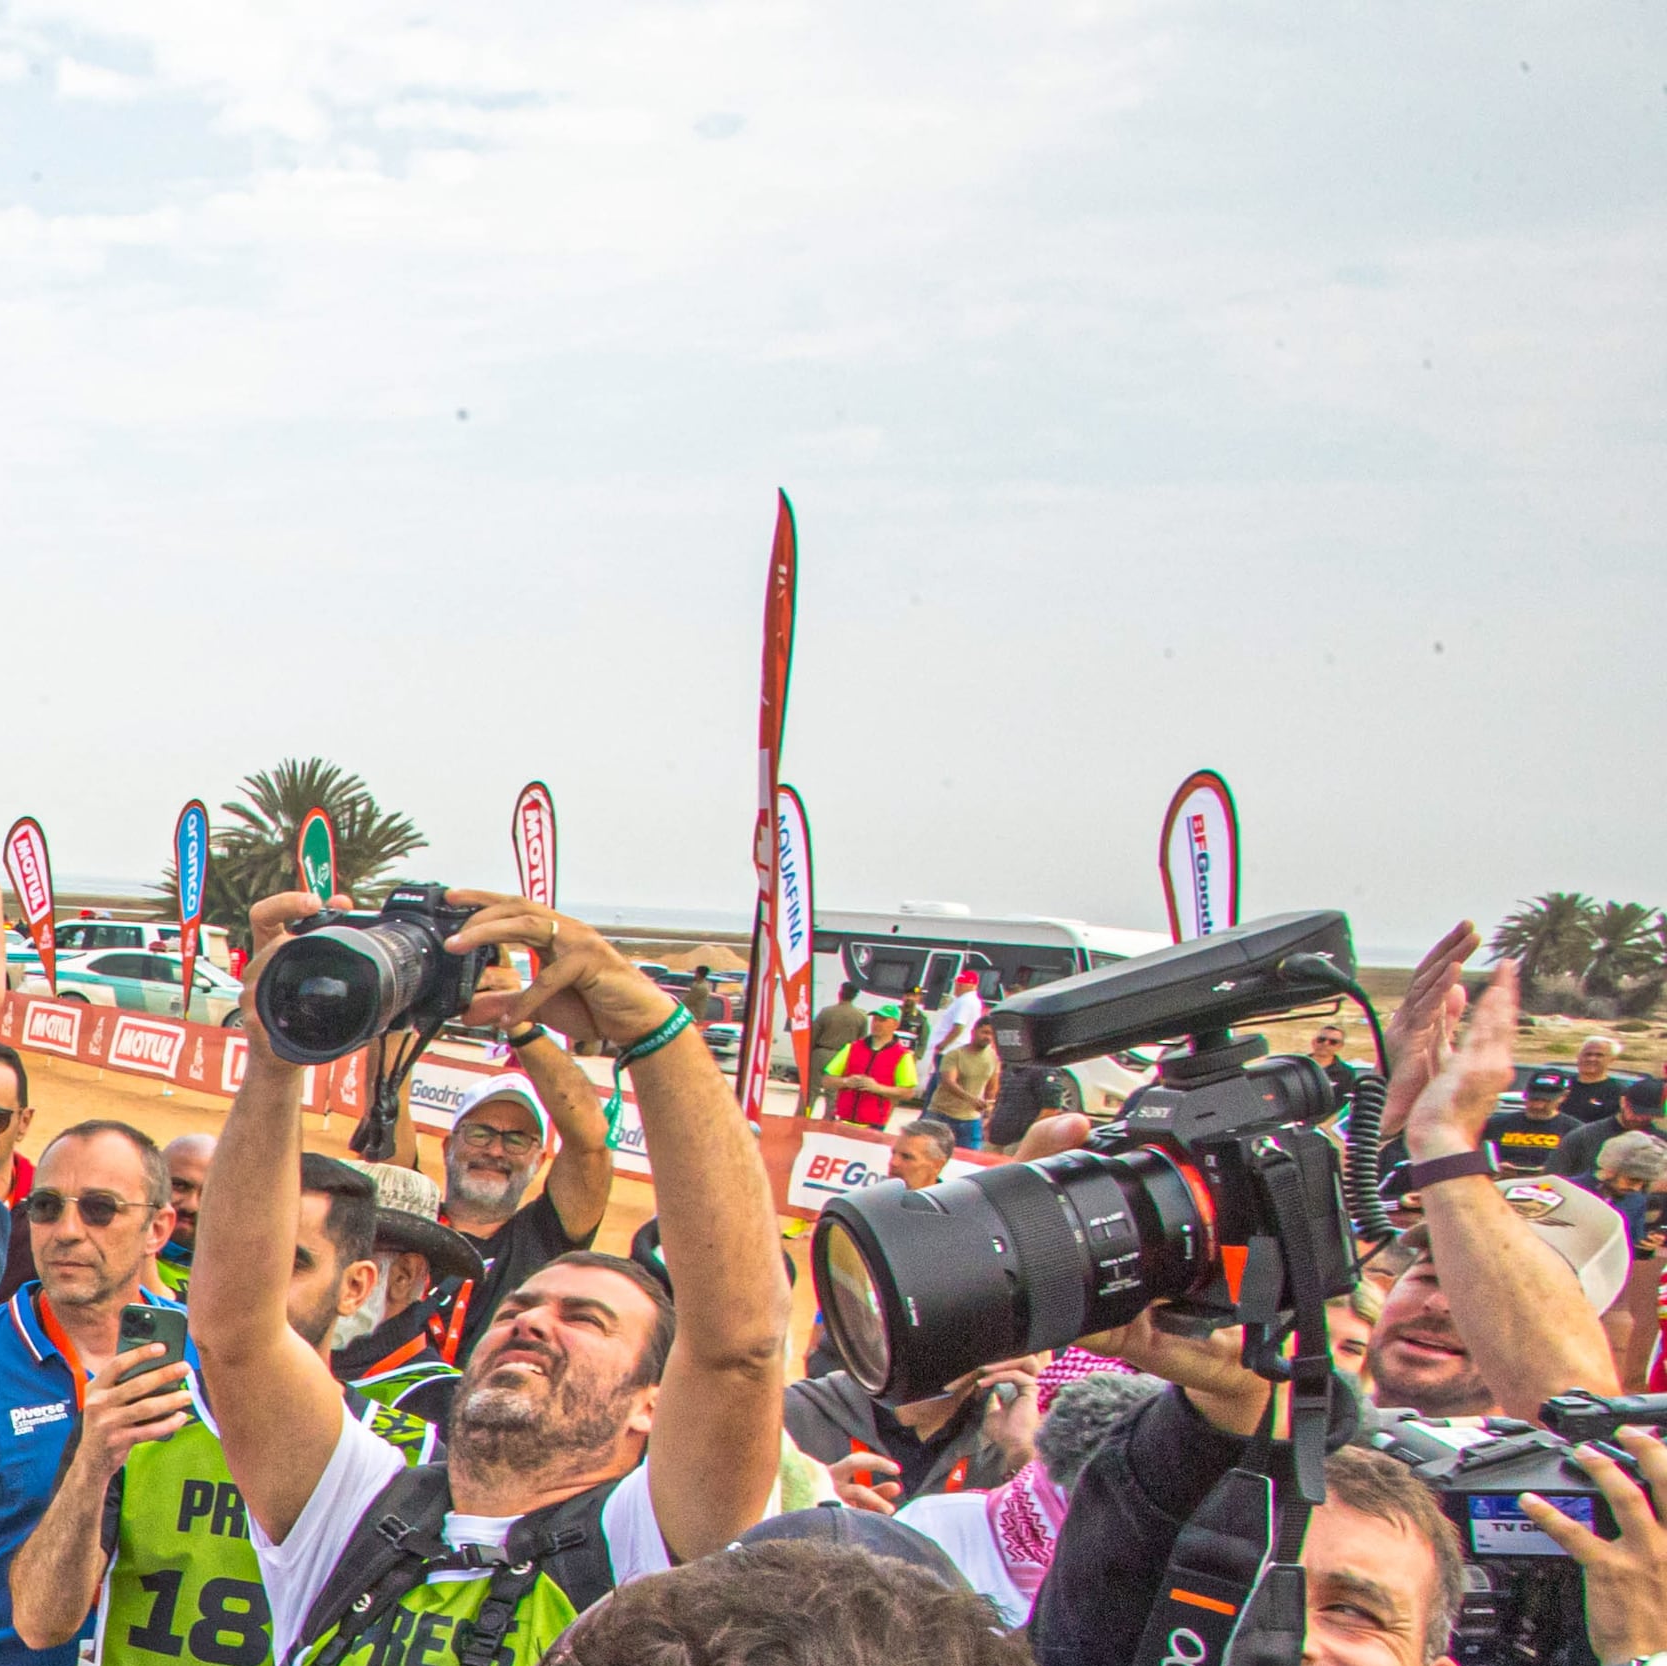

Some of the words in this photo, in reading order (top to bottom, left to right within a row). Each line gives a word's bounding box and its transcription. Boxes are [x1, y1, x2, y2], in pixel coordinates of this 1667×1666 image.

[16, 839, 47, 909] MOTUL
[186, 812, 200, 911] aramco
[524, 808, 547, 902] MOTU
[776, 815, 804, 953] AQUAFINA
[30, 1016, 73, 1044] MOTUL
[117, 1028, 175, 1066] MOTUL
[10, 1403, 65, 1421] Diverse
